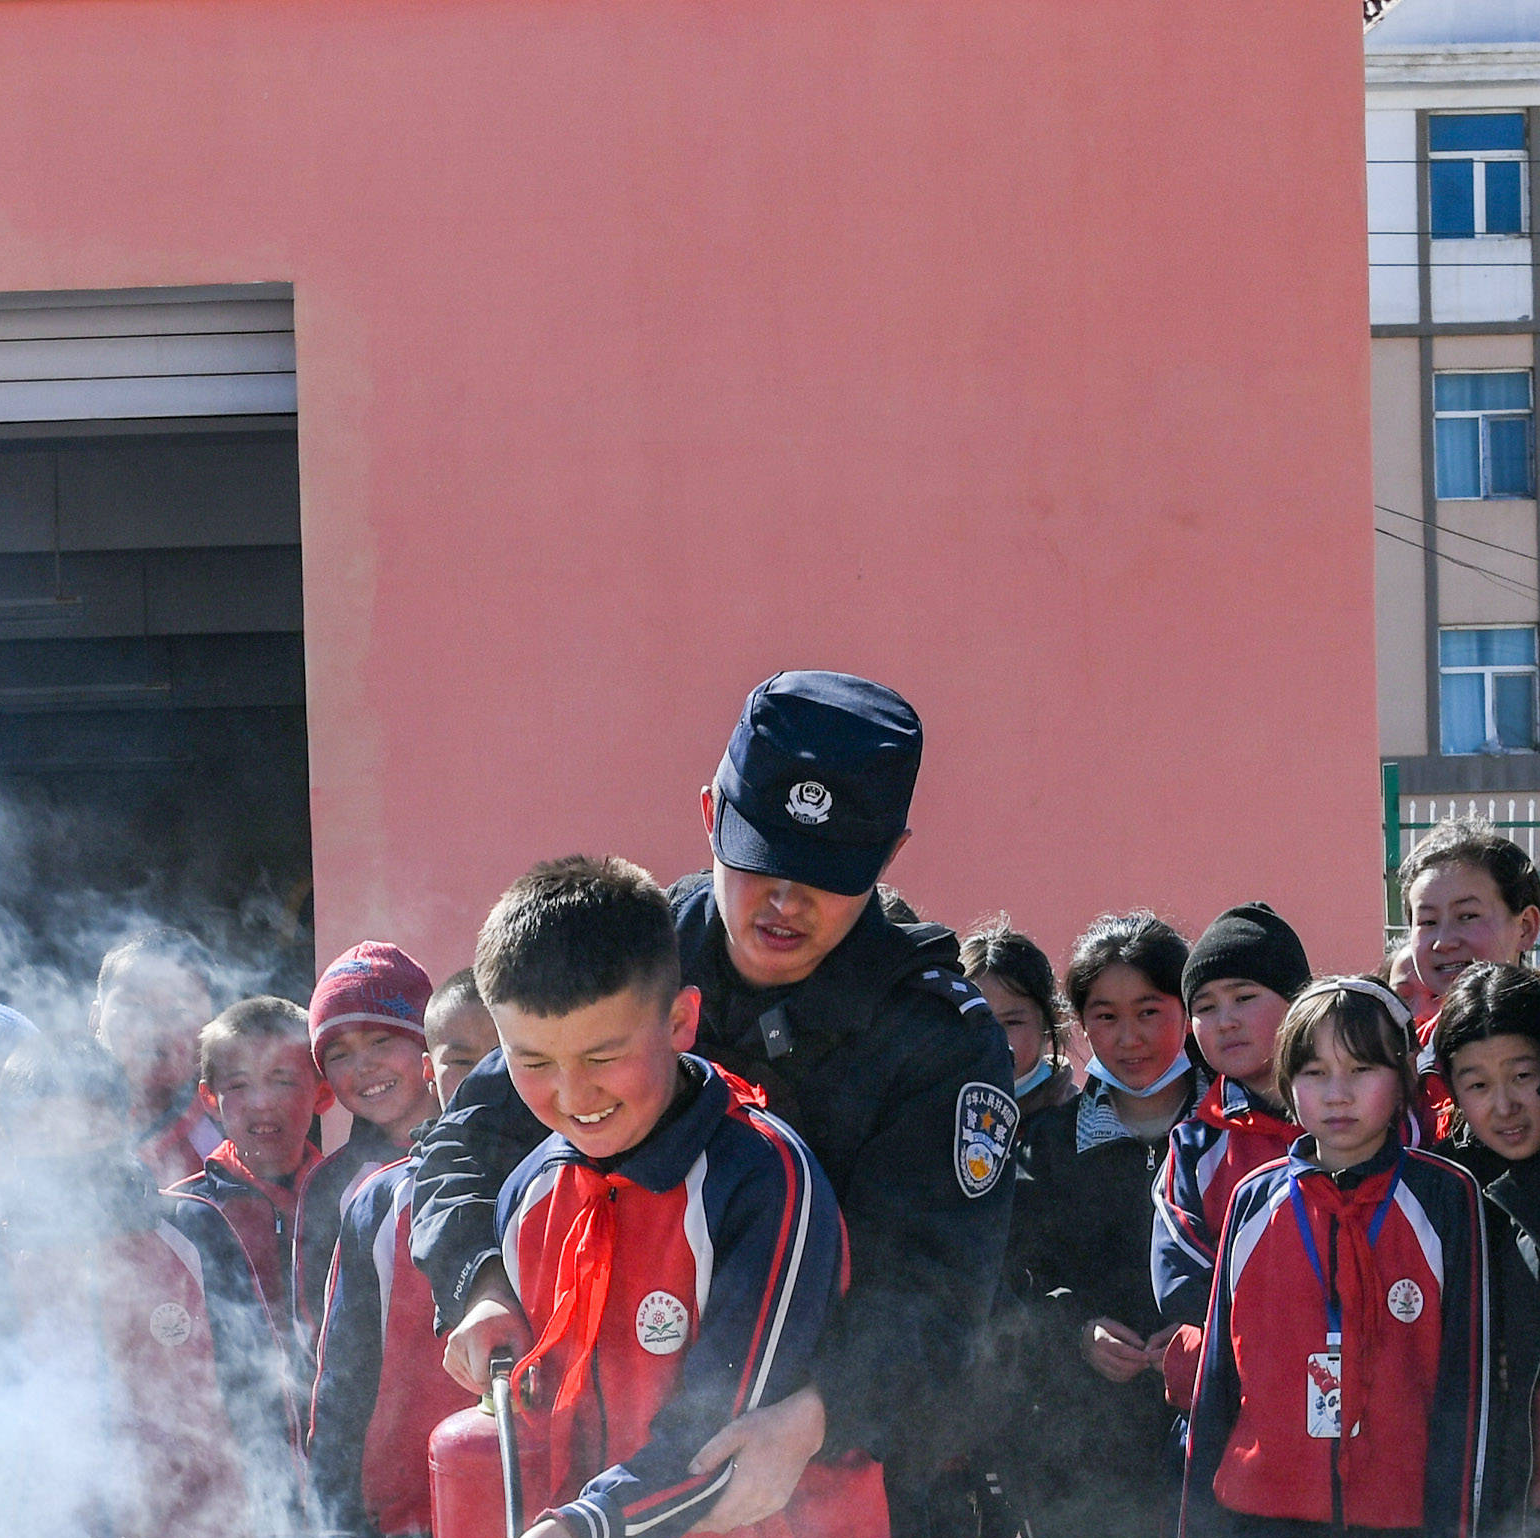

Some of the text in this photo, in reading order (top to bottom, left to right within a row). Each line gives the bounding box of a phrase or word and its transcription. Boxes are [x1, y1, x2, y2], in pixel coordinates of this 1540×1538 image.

[965, 1091, 1015, 1127] 中华人民共和国
[453, 1261, 472, 1301] POLICE
